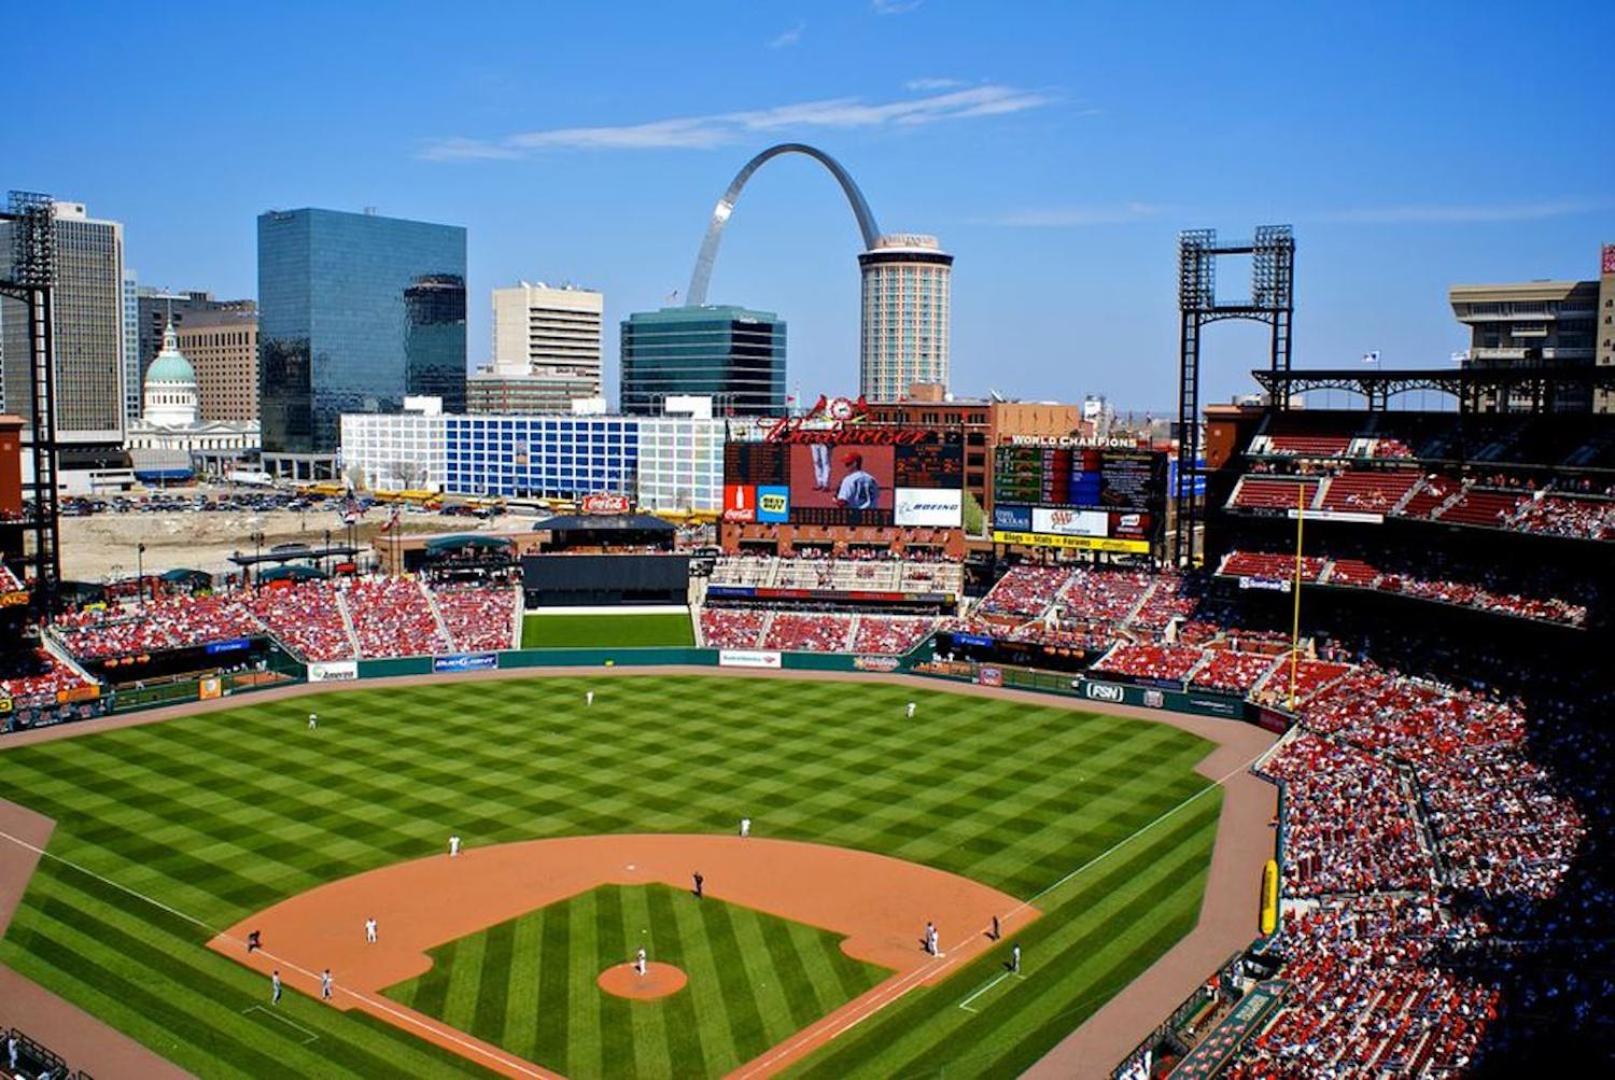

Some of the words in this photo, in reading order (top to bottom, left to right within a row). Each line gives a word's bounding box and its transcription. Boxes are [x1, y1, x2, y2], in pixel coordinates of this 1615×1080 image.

[757, 416, 928, 445] Budweiser
[1011, 435, 1057, 446] WORLD
[1059, 436, 1137, 448] CHAMPIONS
[1051, 510, 1072, 525] AAA
[1003, 534, 1023, 543] Blogs
[1034, 535, 1053, 545] Stats
[1063, 538, 1091, 547] Forums
